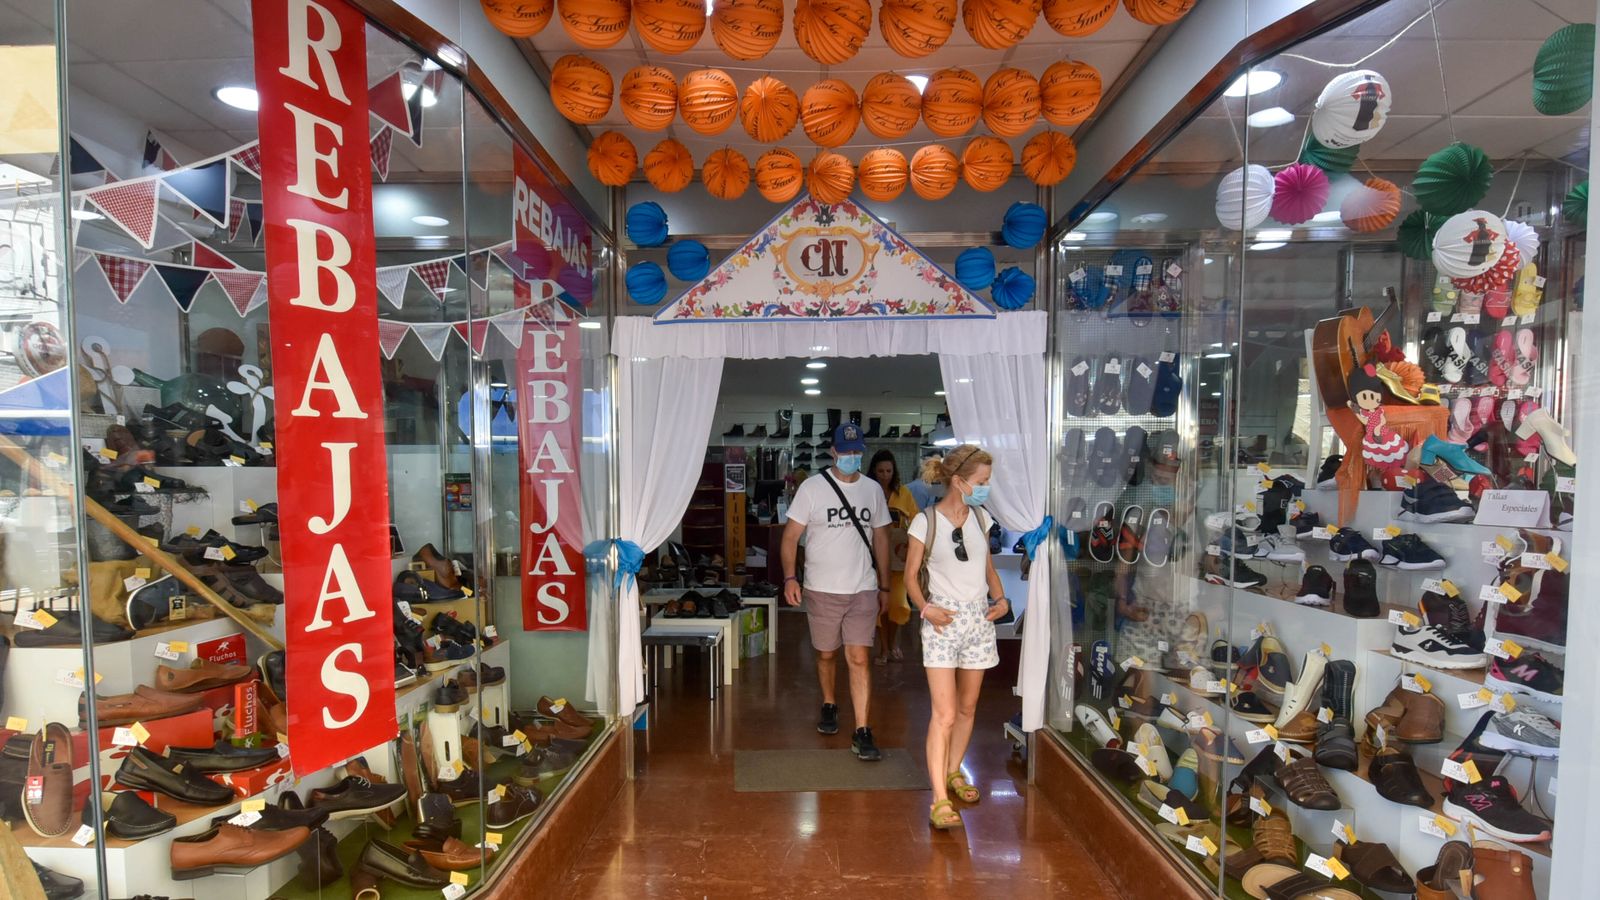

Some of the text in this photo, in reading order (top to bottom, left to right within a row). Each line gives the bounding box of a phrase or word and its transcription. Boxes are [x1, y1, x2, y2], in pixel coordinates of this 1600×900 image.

[513, 175, 588, 279] REBAJAS
[279, 0, 376, 730] REBAJAS
[526, 279, 576, 624] REBAJAS
[1487, 493, 1508, 501] Tallas
[1501, 504, 1538, 514] Especiales
[827, 506, 871, 522] POLO
[209, 651, 237, 662] Fluchos
[244, 686, 253, 736] Fluchos
